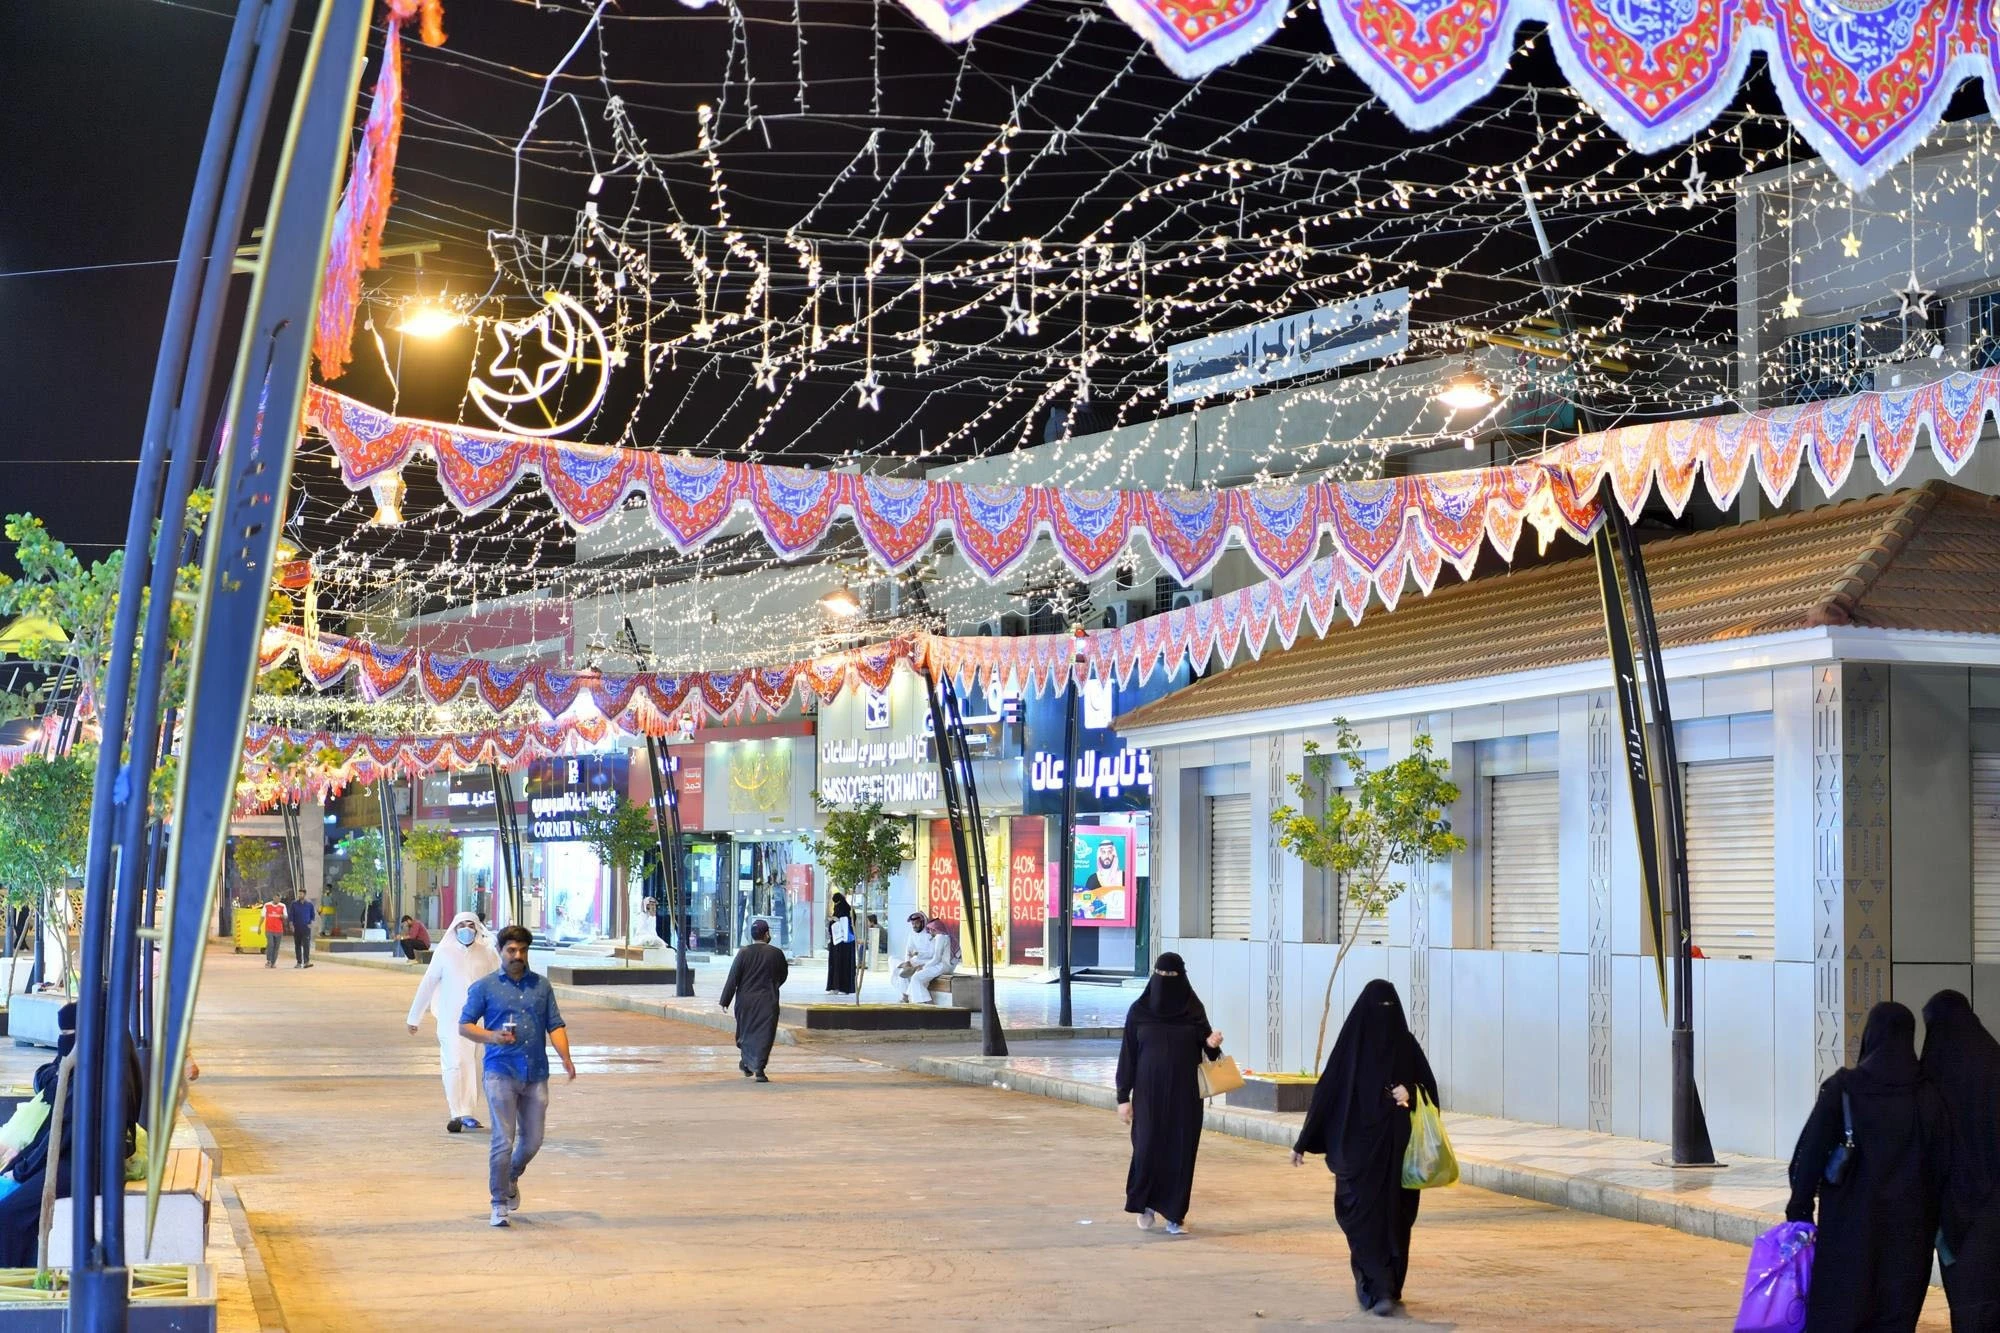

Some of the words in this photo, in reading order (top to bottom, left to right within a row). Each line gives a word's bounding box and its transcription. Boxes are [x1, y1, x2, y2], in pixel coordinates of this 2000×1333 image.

[1095, 748, 1137, 799] تايم
[822, 777, 847, 804] SWISS
[884, 773, 902, 802] FOR
[903, 771, 937, 800] WATCH
[534, 821, 571, 837] CORNER
[932, 856, 952, 875] 40%
[1013, 856, 1035, 875] 40%
[932, 877, 961, 902] 60%
[1013, 877, 1044, 902] 60%
[932, 906, 960, 921] SALE
[1013, 906, 1044, 921] SALE
